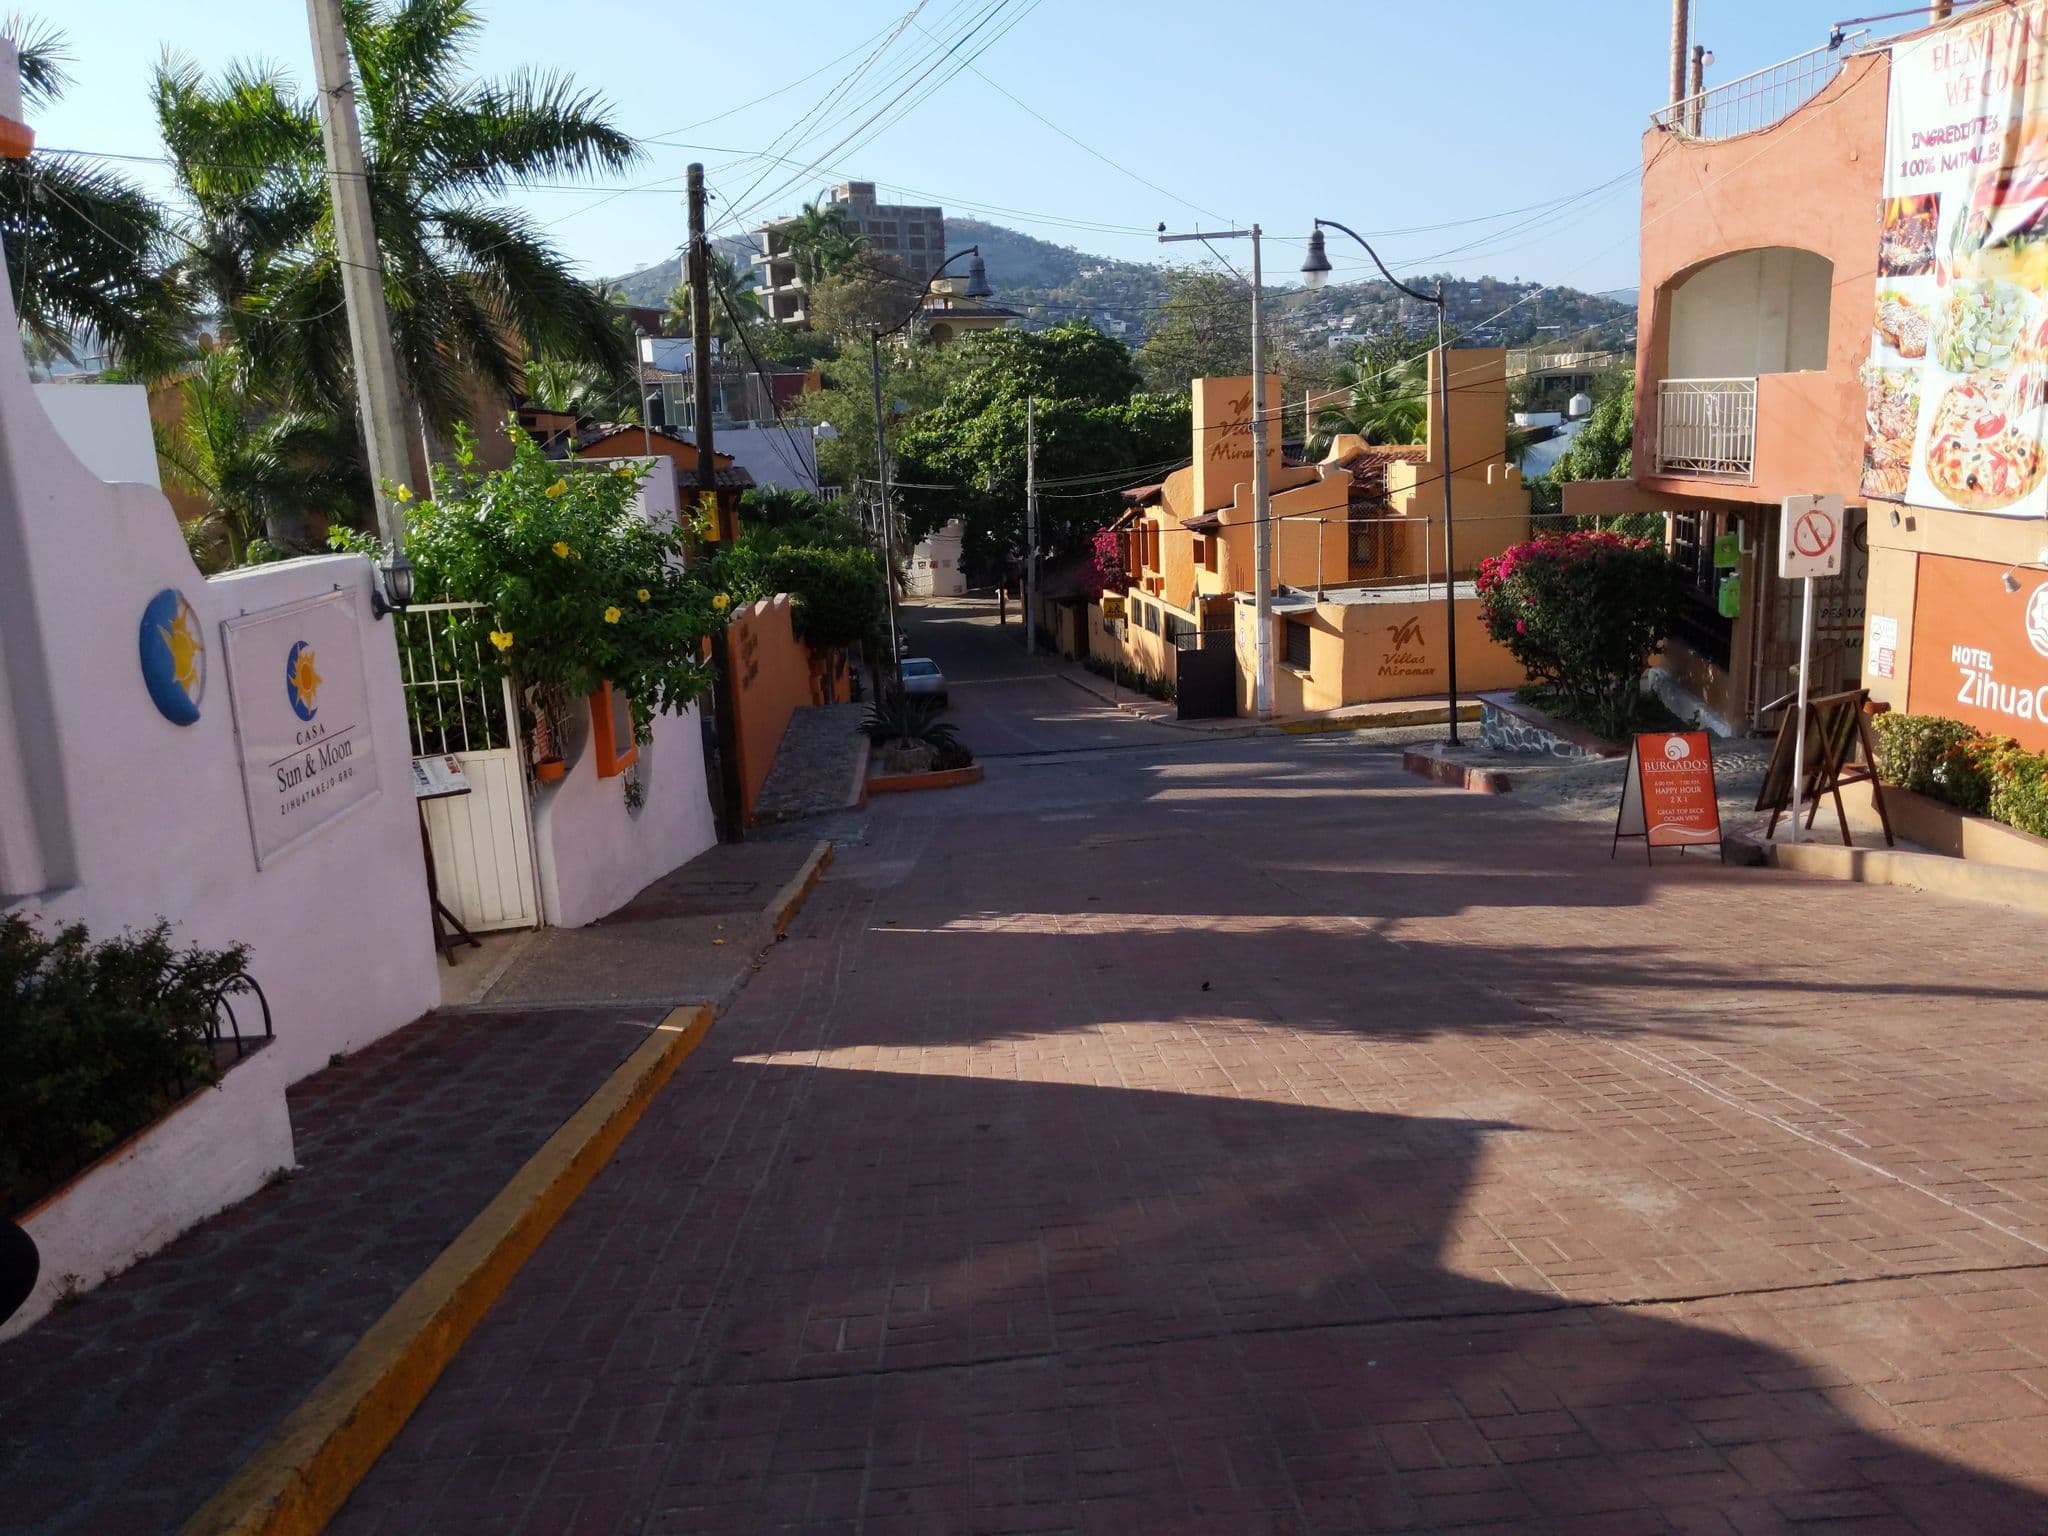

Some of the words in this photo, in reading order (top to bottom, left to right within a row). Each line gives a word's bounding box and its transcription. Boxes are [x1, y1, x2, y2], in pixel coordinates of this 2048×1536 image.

[1900, 157, 1936, 178] 100%
[1382, 652, 1426, 664] Villas
[1951, 645, 1993, 671] HOTEL
[1377, 666, 1436, 676] Miramar
[296, 723, 325, 746] CASA
[276, 766, 303, 793] Sun
[305, 753, 317, 778] &
[318, 740, 353, 771] Moon
[1655, 786, 1678, 795] HAPPY
[1680, 785, 1702, 794] HOUR
